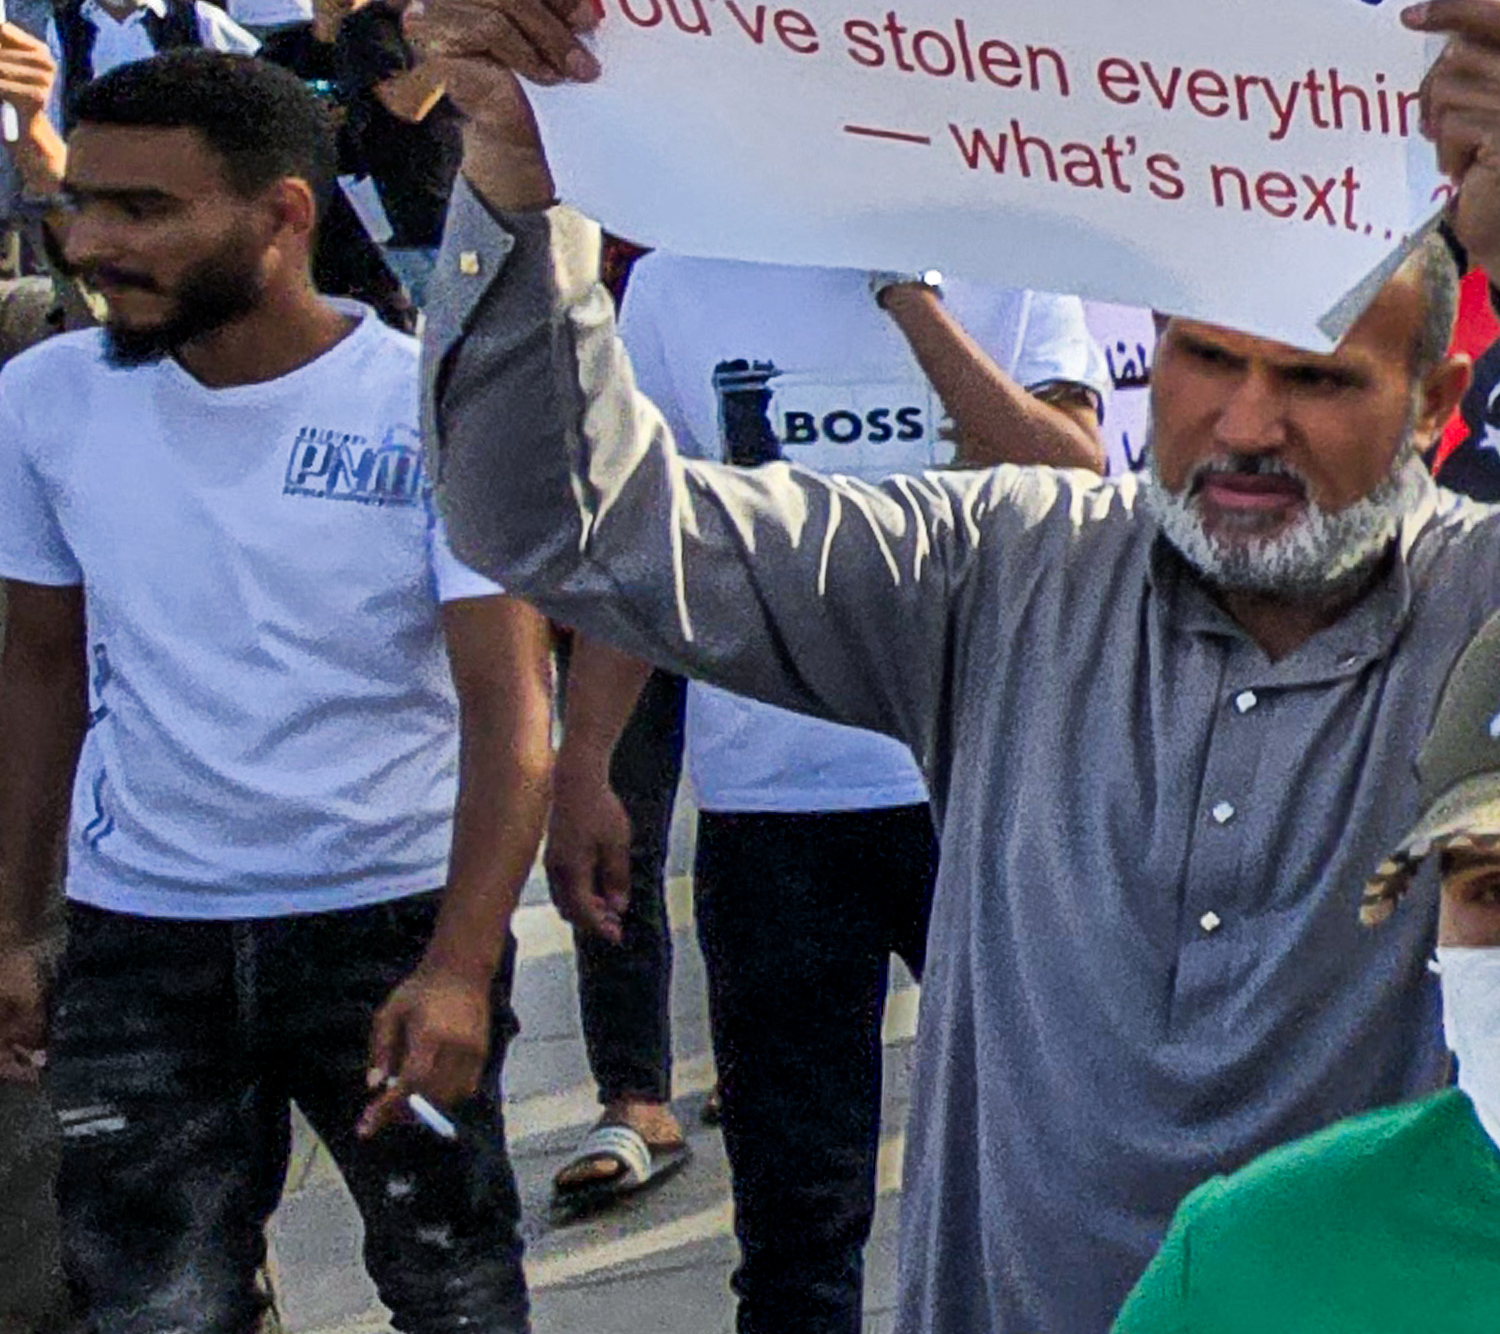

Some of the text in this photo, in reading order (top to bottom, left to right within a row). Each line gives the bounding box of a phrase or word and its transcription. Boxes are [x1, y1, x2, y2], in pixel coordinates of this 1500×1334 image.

[843, 17, 1071, 97] stolen
[946, 120, 1183, 201] what's
[780, 406, 925, 445] BOSS
